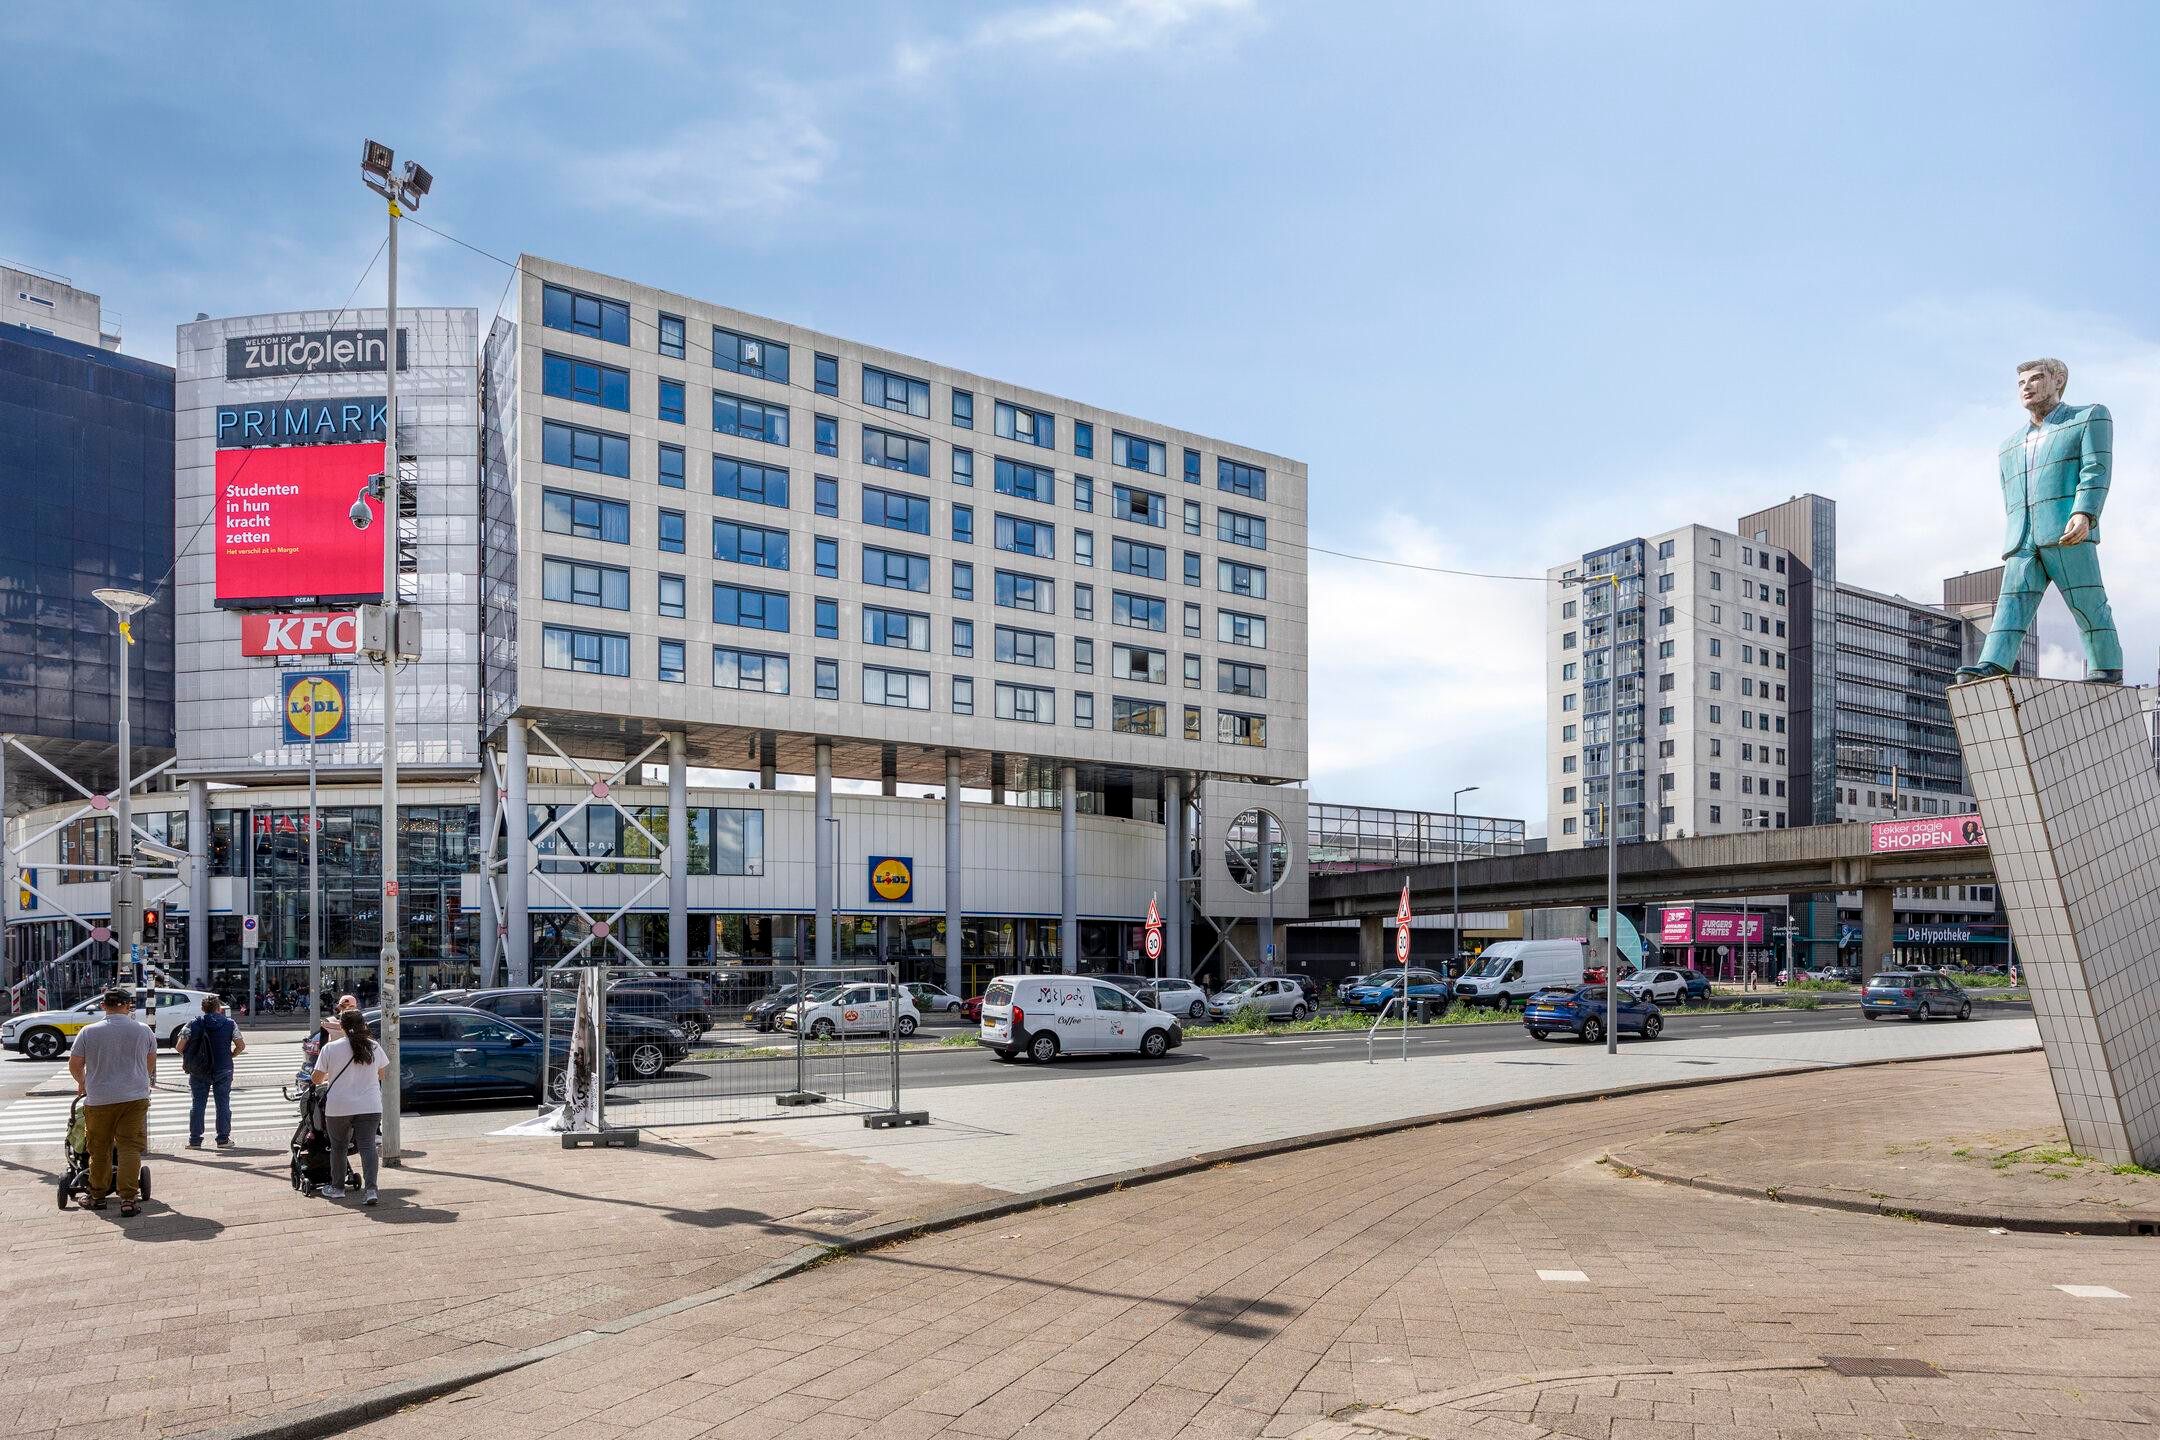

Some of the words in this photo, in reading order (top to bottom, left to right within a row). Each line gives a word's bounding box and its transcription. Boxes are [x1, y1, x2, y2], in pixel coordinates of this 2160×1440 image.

[245, 337, 278, 346] WELKOM
[245, 333, 385, 370] zuidplein
[219, 404, 387, 438] PRIMARK
[226, 483, 299, 497] Studenten
[226, 500, 239, 512] in
[243, 499, 270, 512] hun
[226, 514, 270, 528] kracht
[226, 532, 270, 543] zetten
[277, 546, 299, 554] Margot
[263, 616, 356, 650] KFC
[1879, 824, 1910, 835] Lekker
[1912, 821, 1943, 832] dagje
[1878, 831, 1952, 848] SHOPPEN
[1399, 936, 1406, 949] 30
[1908, 927, 1920, 940] De
[1921, 927, 1970, 944] Hypotheker
[1149, 938, 1158, 949] 30
[1057, 1015, 1081, 1025] Coffee
